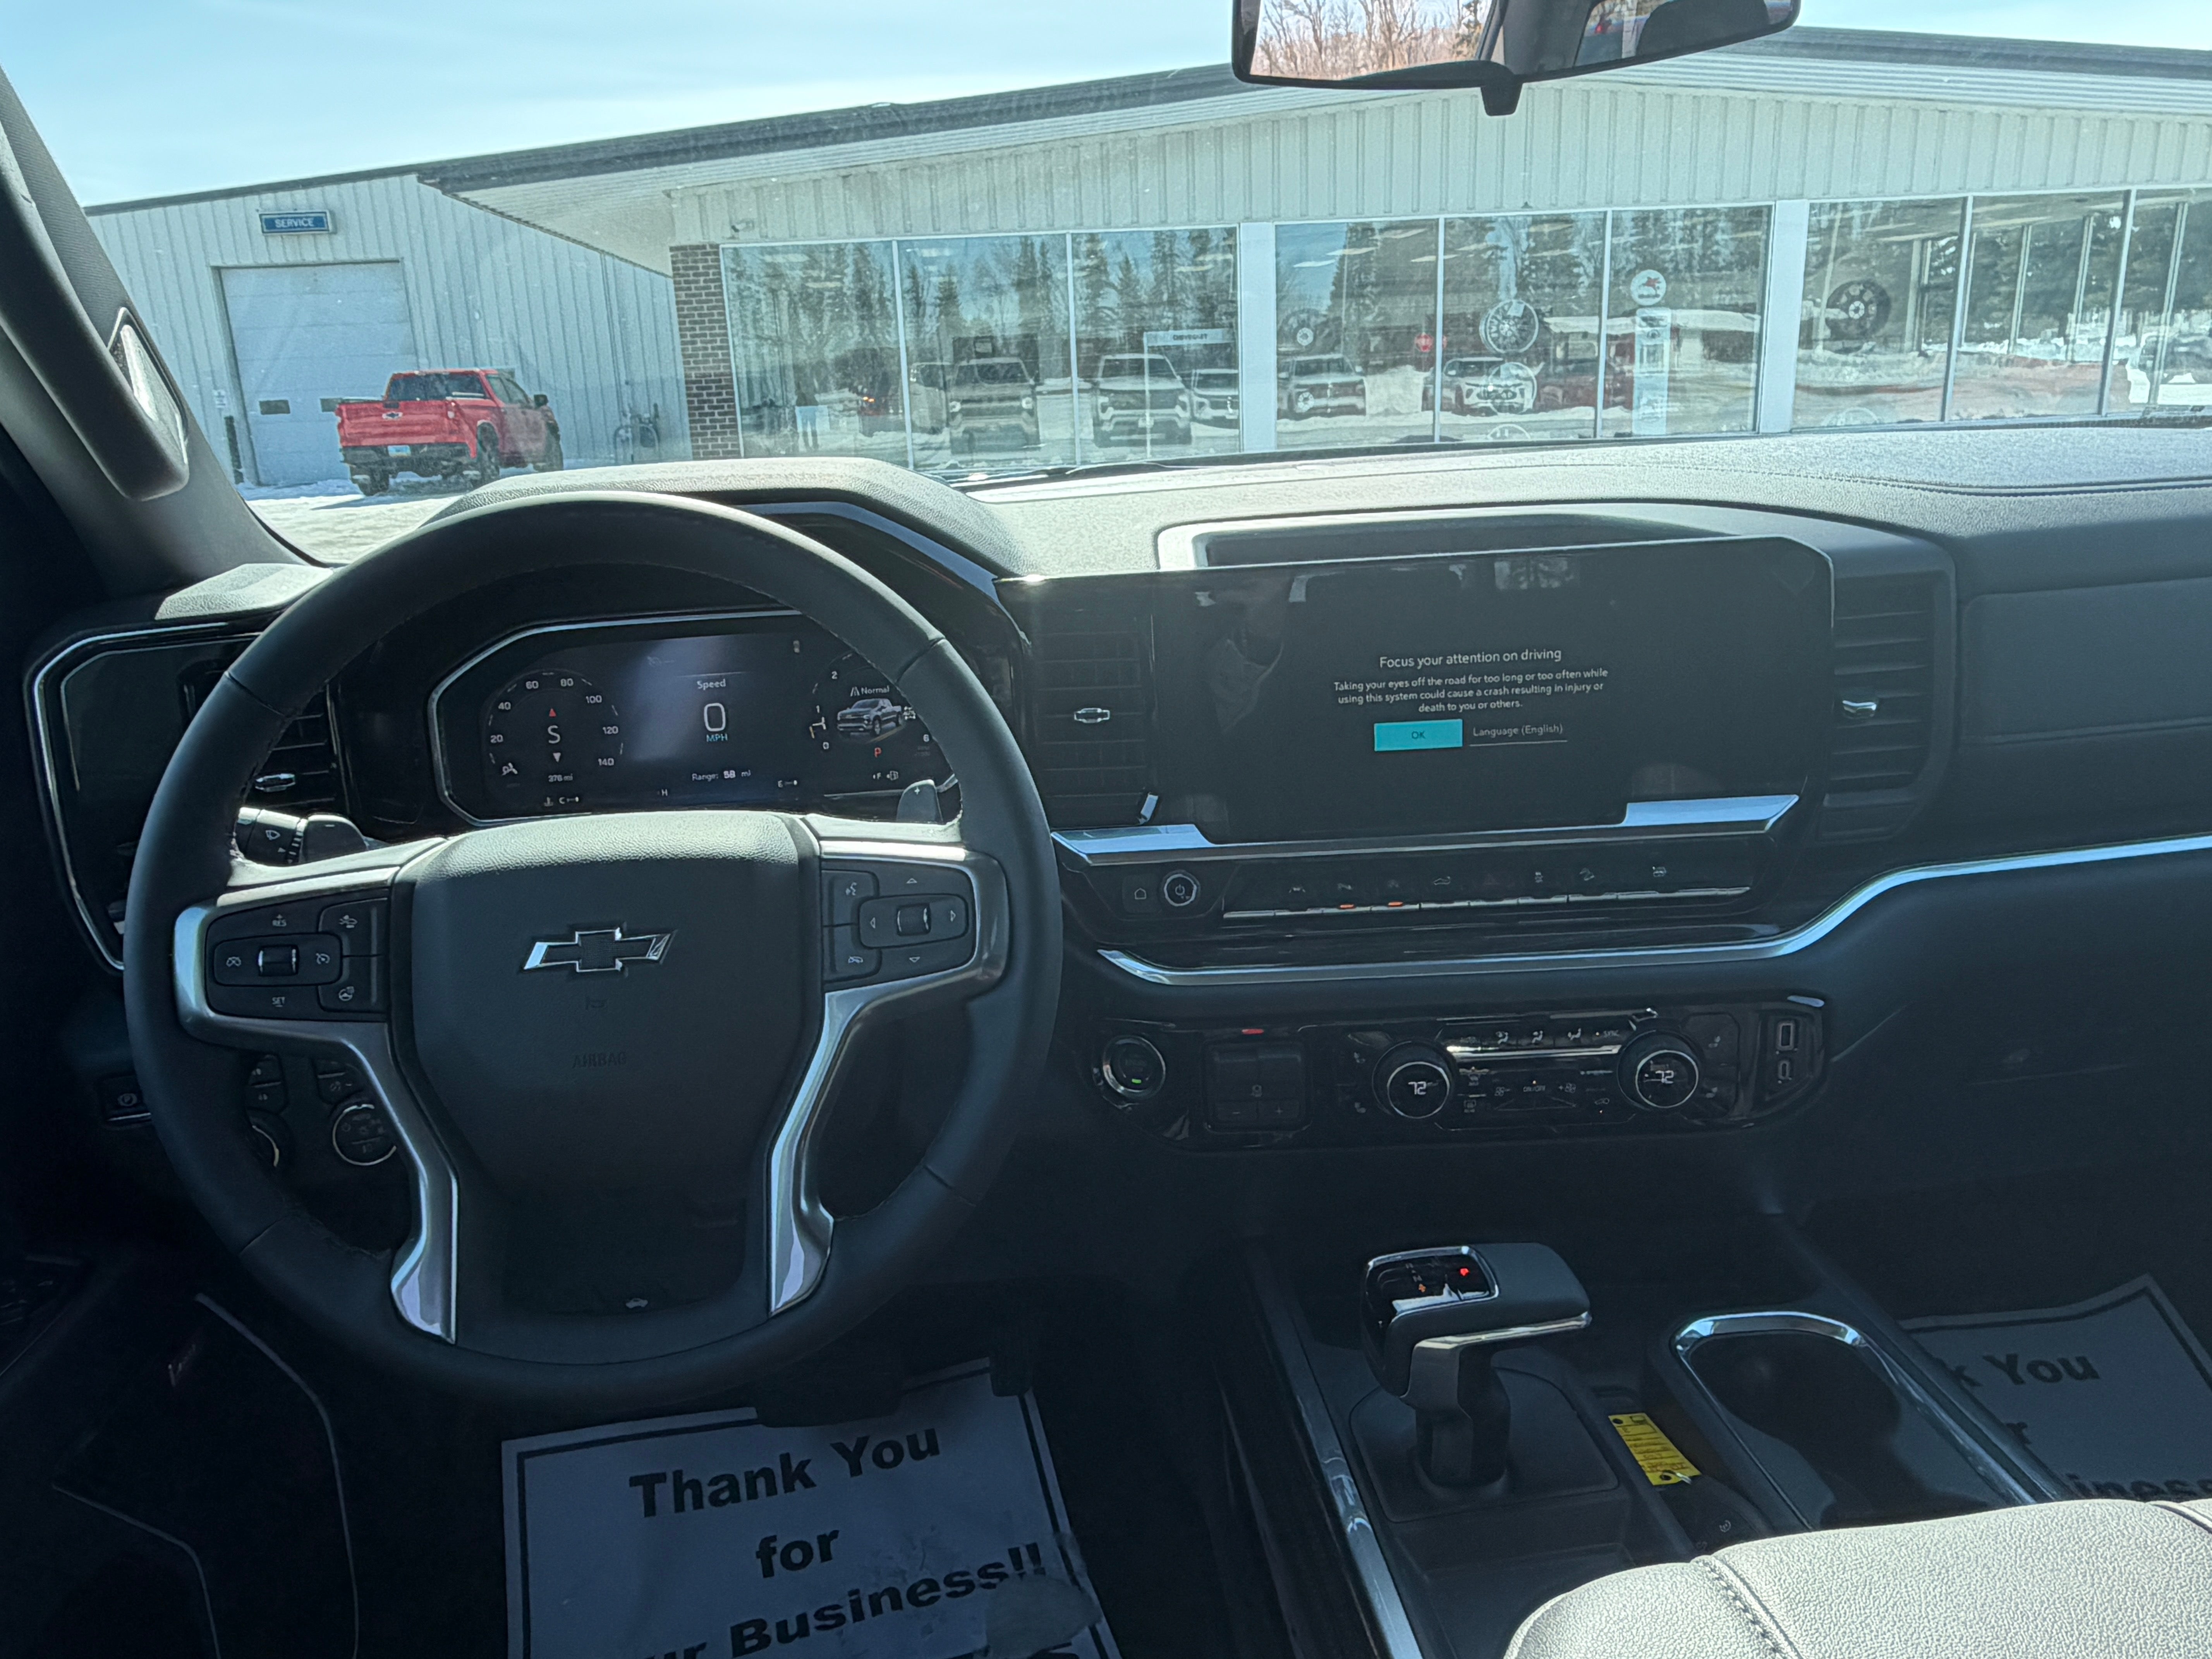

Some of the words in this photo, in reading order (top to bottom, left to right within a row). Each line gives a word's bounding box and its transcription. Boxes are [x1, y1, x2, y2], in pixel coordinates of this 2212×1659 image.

[274, 217, 314, 228] SERVICE
[1379, 656, 1415, 668] Focus
[1417, 656, 1443, 670] your
[1446, 652, 1500, 665] attention
[1503, 652, 1518, 662] on
[1521, 649, 1561, 662] driving
[831, 671, 838, 680] 2
[1334, 681, 1364, 692] Taking
[1365, 682, 1386, 691] your
[1388, 680, 1410, 690] eyes
[1411, 677, 1425, 687] off
[1427, 676, 1443, 686] the
[1445, 675, 1466, 685] road
[1468, 674, 1482, 684] for
[1484, 675, 1500, 683] too
[1502, 673, 1523, 684] long
[1555, 669, 1581, 679] often
[1583, 667, 1609, 678] while
[526, 681, 539, 689] 60
[560, 678, 574, 687] 80
[697, 679, 726, 690] Speed
[861, 685, 890, 695] Normal
[1338, 694, 1364, 705] using
[1366, 693, 1383, 702] this
[1385, 692, 1418, 703] system
[1420, 689, 1445, 699] could
[1447, 689, 1474, 698] cause
[1484, 685, 1509, 696] crash
[1511, 684, 1552, 696] resulting
[1554, 683, 1563, 692] in
[1565, 682, 1591, 694] injury
[586, 695, 602, 704] 100
[498, 702, 512, 710] 40
[816, 705, 820, 713] 1
[1418, 702, 1445, 713] death
[1447, 703, 1456, 711] to
[1458, 702, 1476, 713] you
[1490, 699, 1523, 709] others.
[704, 702, 726, 732] 0
[547, 725, 561, 744] S
[602, 726, 619, 735] 120
[1411, 730, 1426, 739] OK
[1473, 727, 1519, 738] Language
[1522, 724, 1563, 737] (English)
[490, 735, 504, 743] 20
[706, 733, 728, 742] MPH
[874, 747, 882, 758] P
[598, 757, 615, 766] 140
[692, 773, 719, 782] Range:
[272, 996, 285, 1005] SET
[572, 1051, 628, 1068] AIRBAG
[1655, 1070, 1674, 1084] 72
[1408, 1081, 1427, 1095] 72
[1982, 1353, 2100, 1385] You
[629, 1451, 817, 1519] Thank
[830, 1427, 942, 1479] You
[755, 1529, 840, 1579] for
